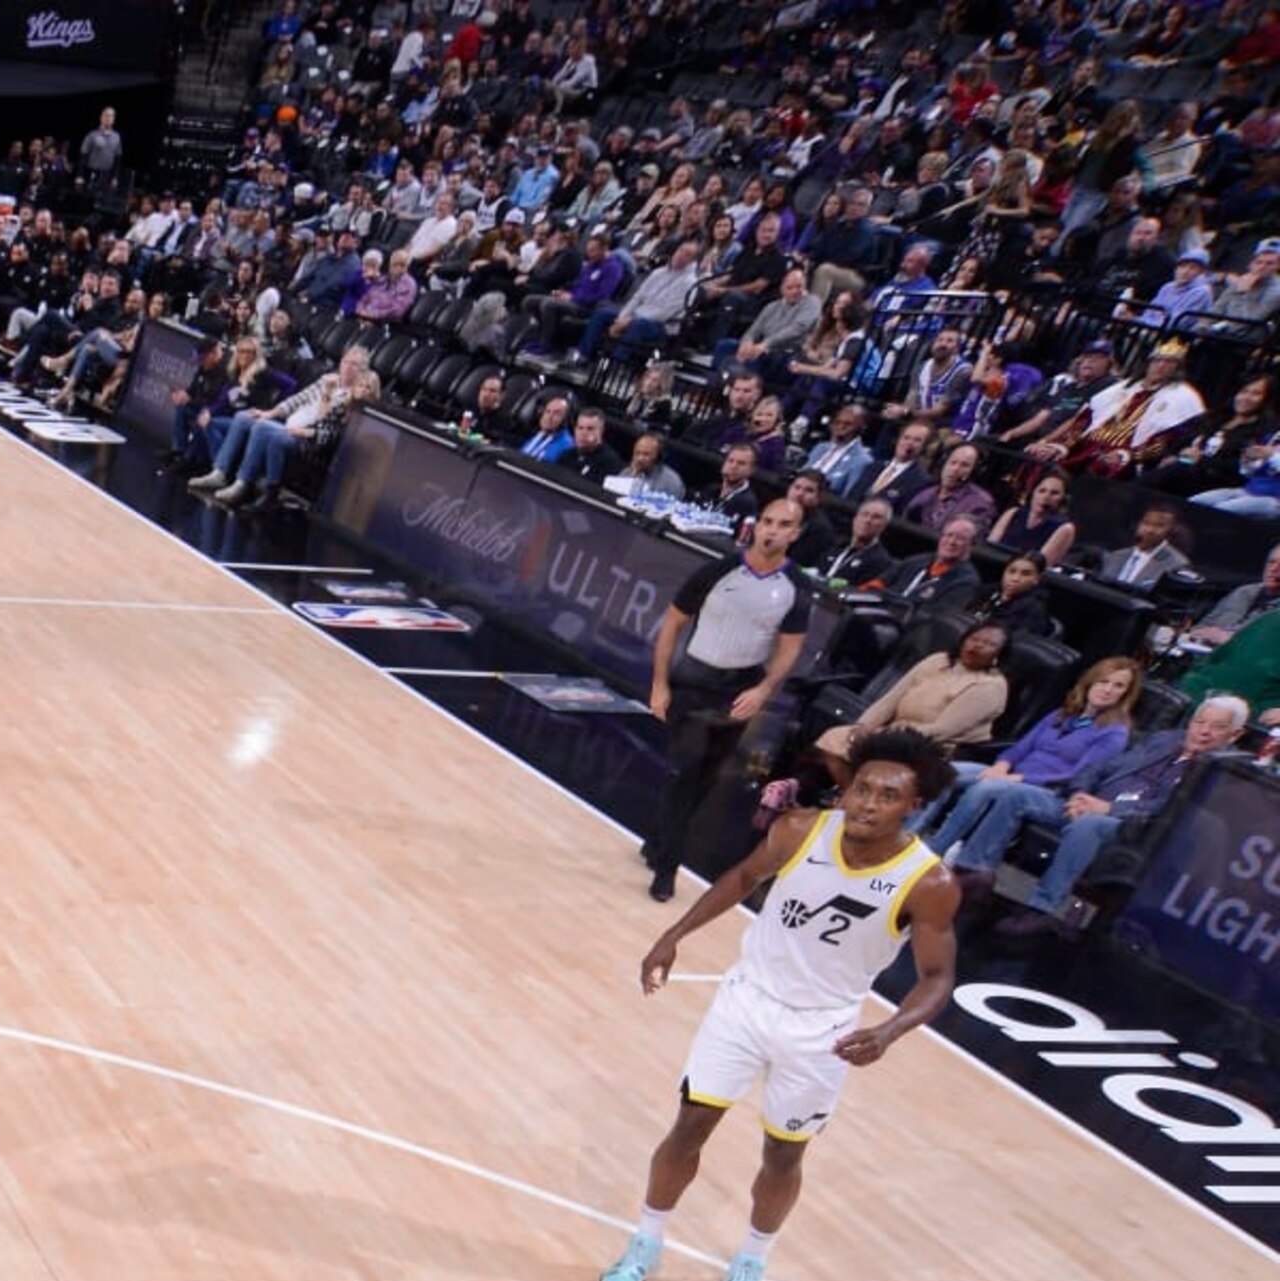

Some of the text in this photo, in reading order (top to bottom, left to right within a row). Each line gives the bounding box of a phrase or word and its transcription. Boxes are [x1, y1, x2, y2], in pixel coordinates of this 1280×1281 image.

[26, 11, 96, 47] Kings
[818, 913, 852, 946] 2
[952, 982, 1280, 1203] dia
